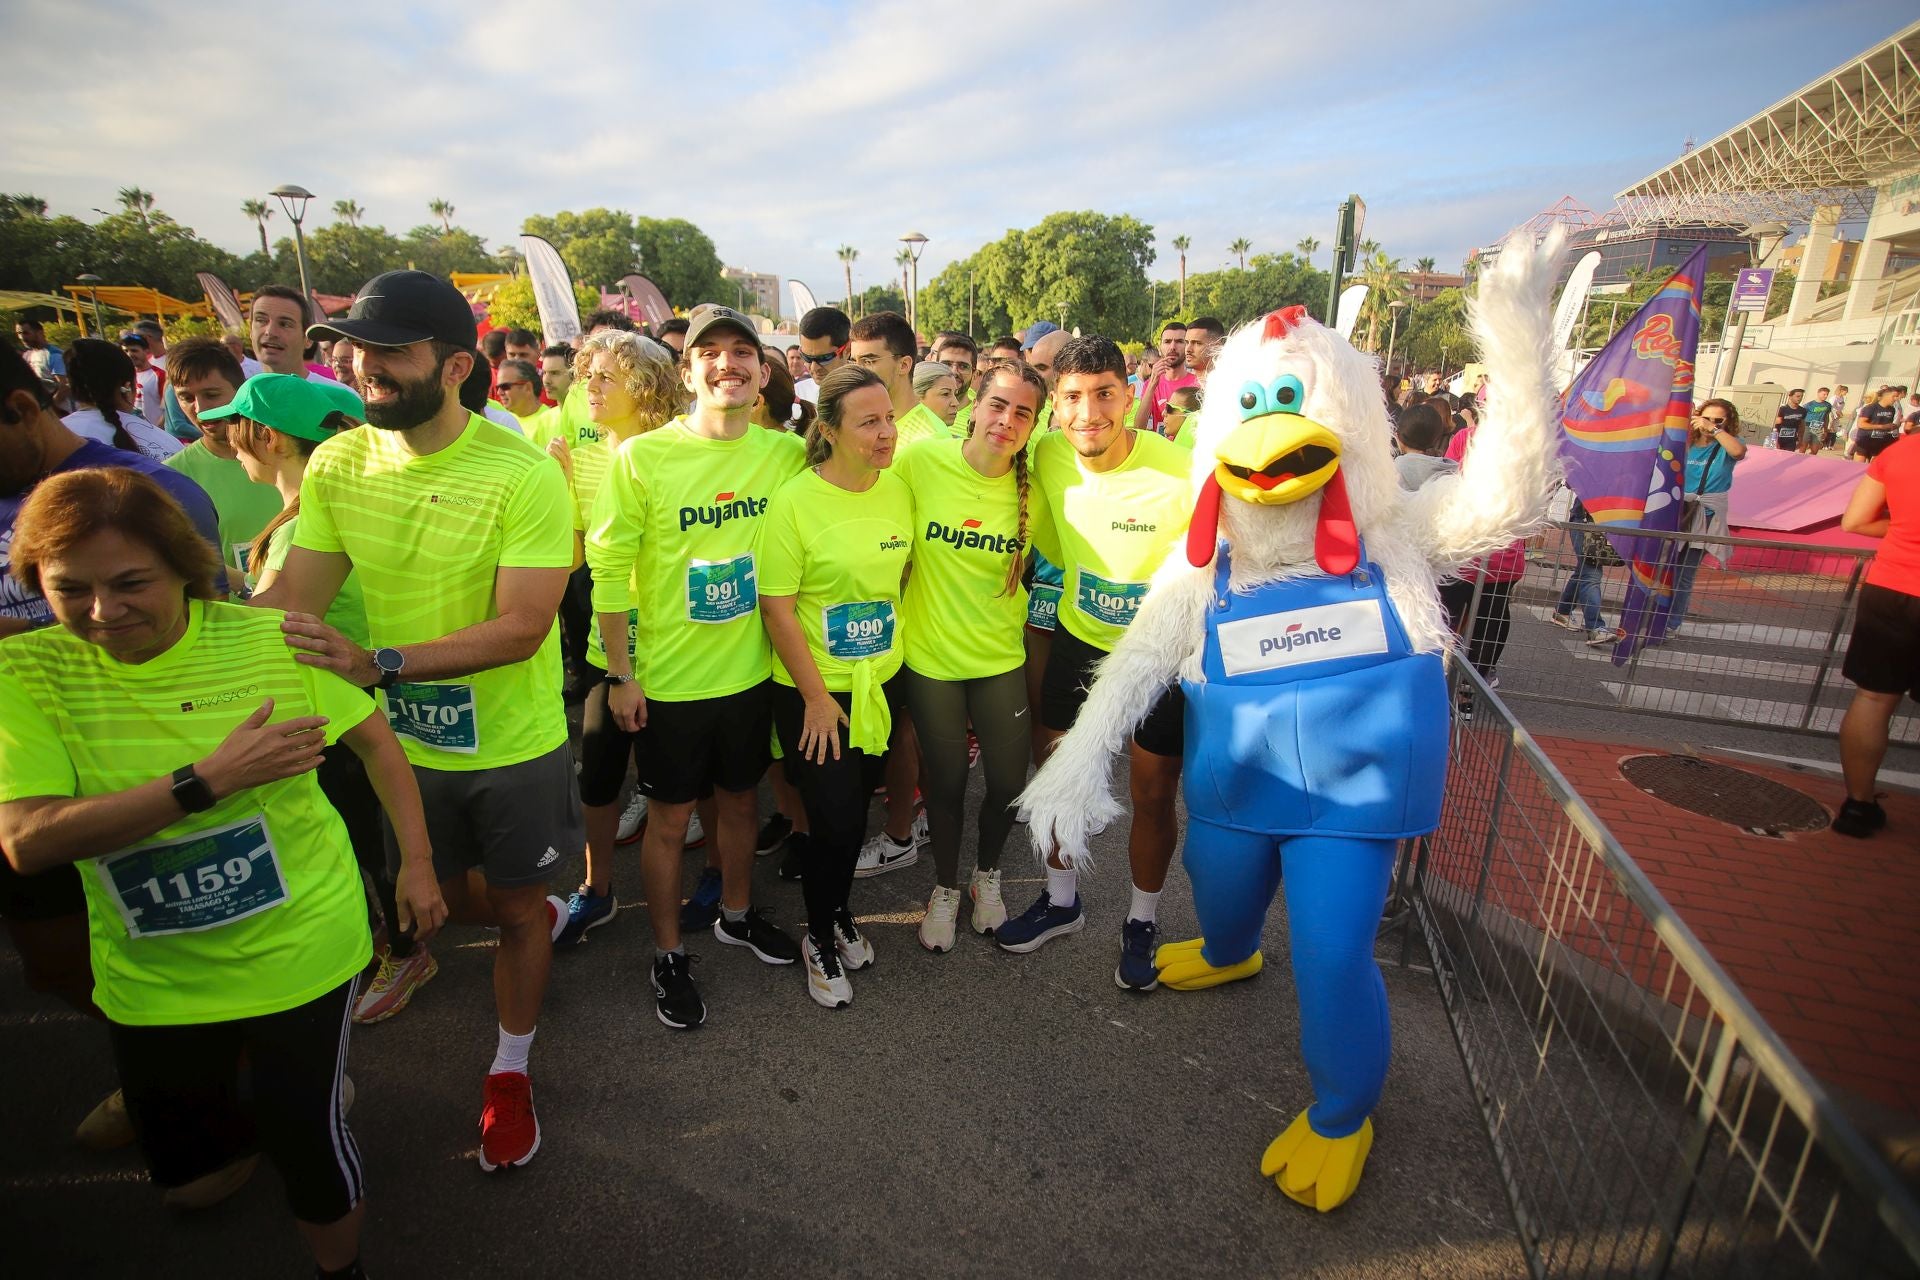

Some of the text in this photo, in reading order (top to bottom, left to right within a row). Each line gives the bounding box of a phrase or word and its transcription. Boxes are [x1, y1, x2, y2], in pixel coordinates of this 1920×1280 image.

[579, 427, 599, 442] puj
[679, 496, 768, 532] pujante
[925, 521, 1020, 554] pujante
[1111, 521, 1156, 533] pujante
[705, 578, 739, 602] 991
[1089, 588, 1145, 610] 1001
[846, 618, 884, 639] 990
[1259, 627, 1342, 656] pujante
[195, 684, 258, 709] TAKASAGO
[397, 698, 459, 725] 1170
[142, 857, 252, 904] 1159
